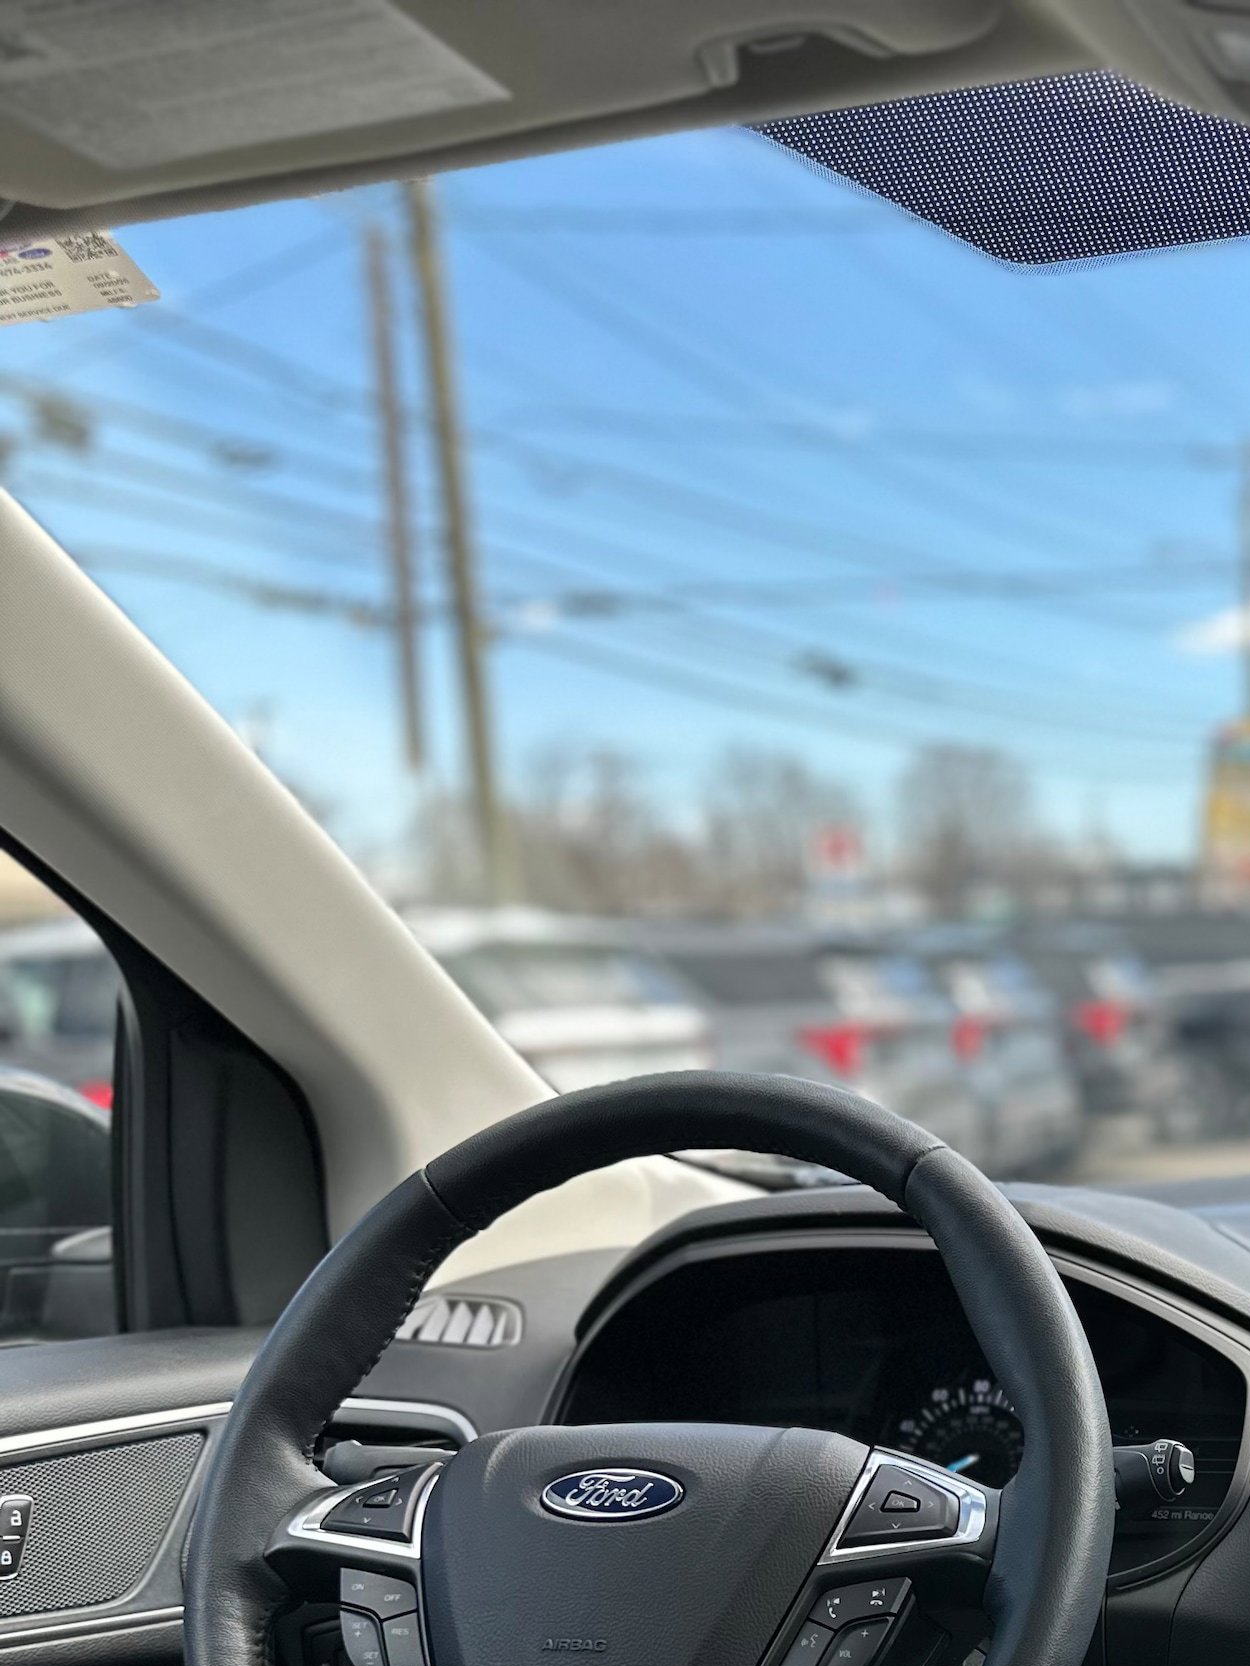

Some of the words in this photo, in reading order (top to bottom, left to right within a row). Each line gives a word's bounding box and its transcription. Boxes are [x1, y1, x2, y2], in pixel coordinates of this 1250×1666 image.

[566, 1472, 654, 1508] Ford
[1151, 1511, 1169, 1520] 452
[1171, 1511, 1182, 1520] mi
[351, 1584, 365, 1592] ON
[384, 1594, 401, 1602] OFF
[542, 1639, 607, 1653] AIRBAG
[838, 1650, 851, 1658] VOL
